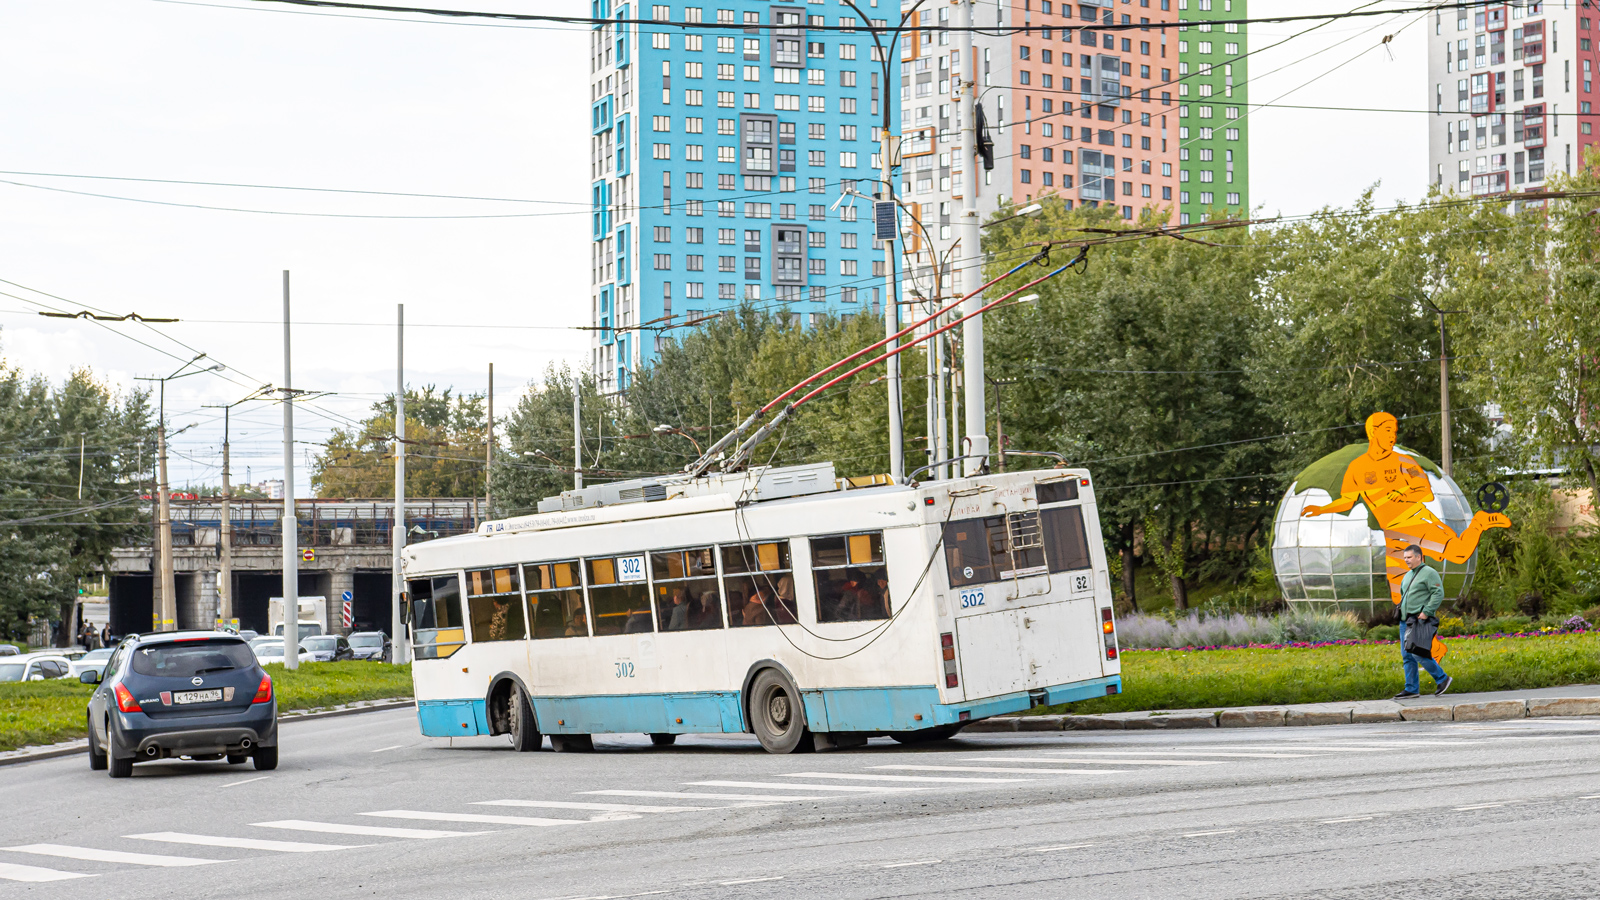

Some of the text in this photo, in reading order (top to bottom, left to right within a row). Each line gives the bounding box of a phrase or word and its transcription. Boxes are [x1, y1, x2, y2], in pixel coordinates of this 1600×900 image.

[943, 504, 980, 518] СБЛЮДАЙ
[622, 558, 641, 574] 302
[1075, 575, 1088, 590] 32
[961, 592, 985, 608] 302
[614, 661, 636, 679] 302
